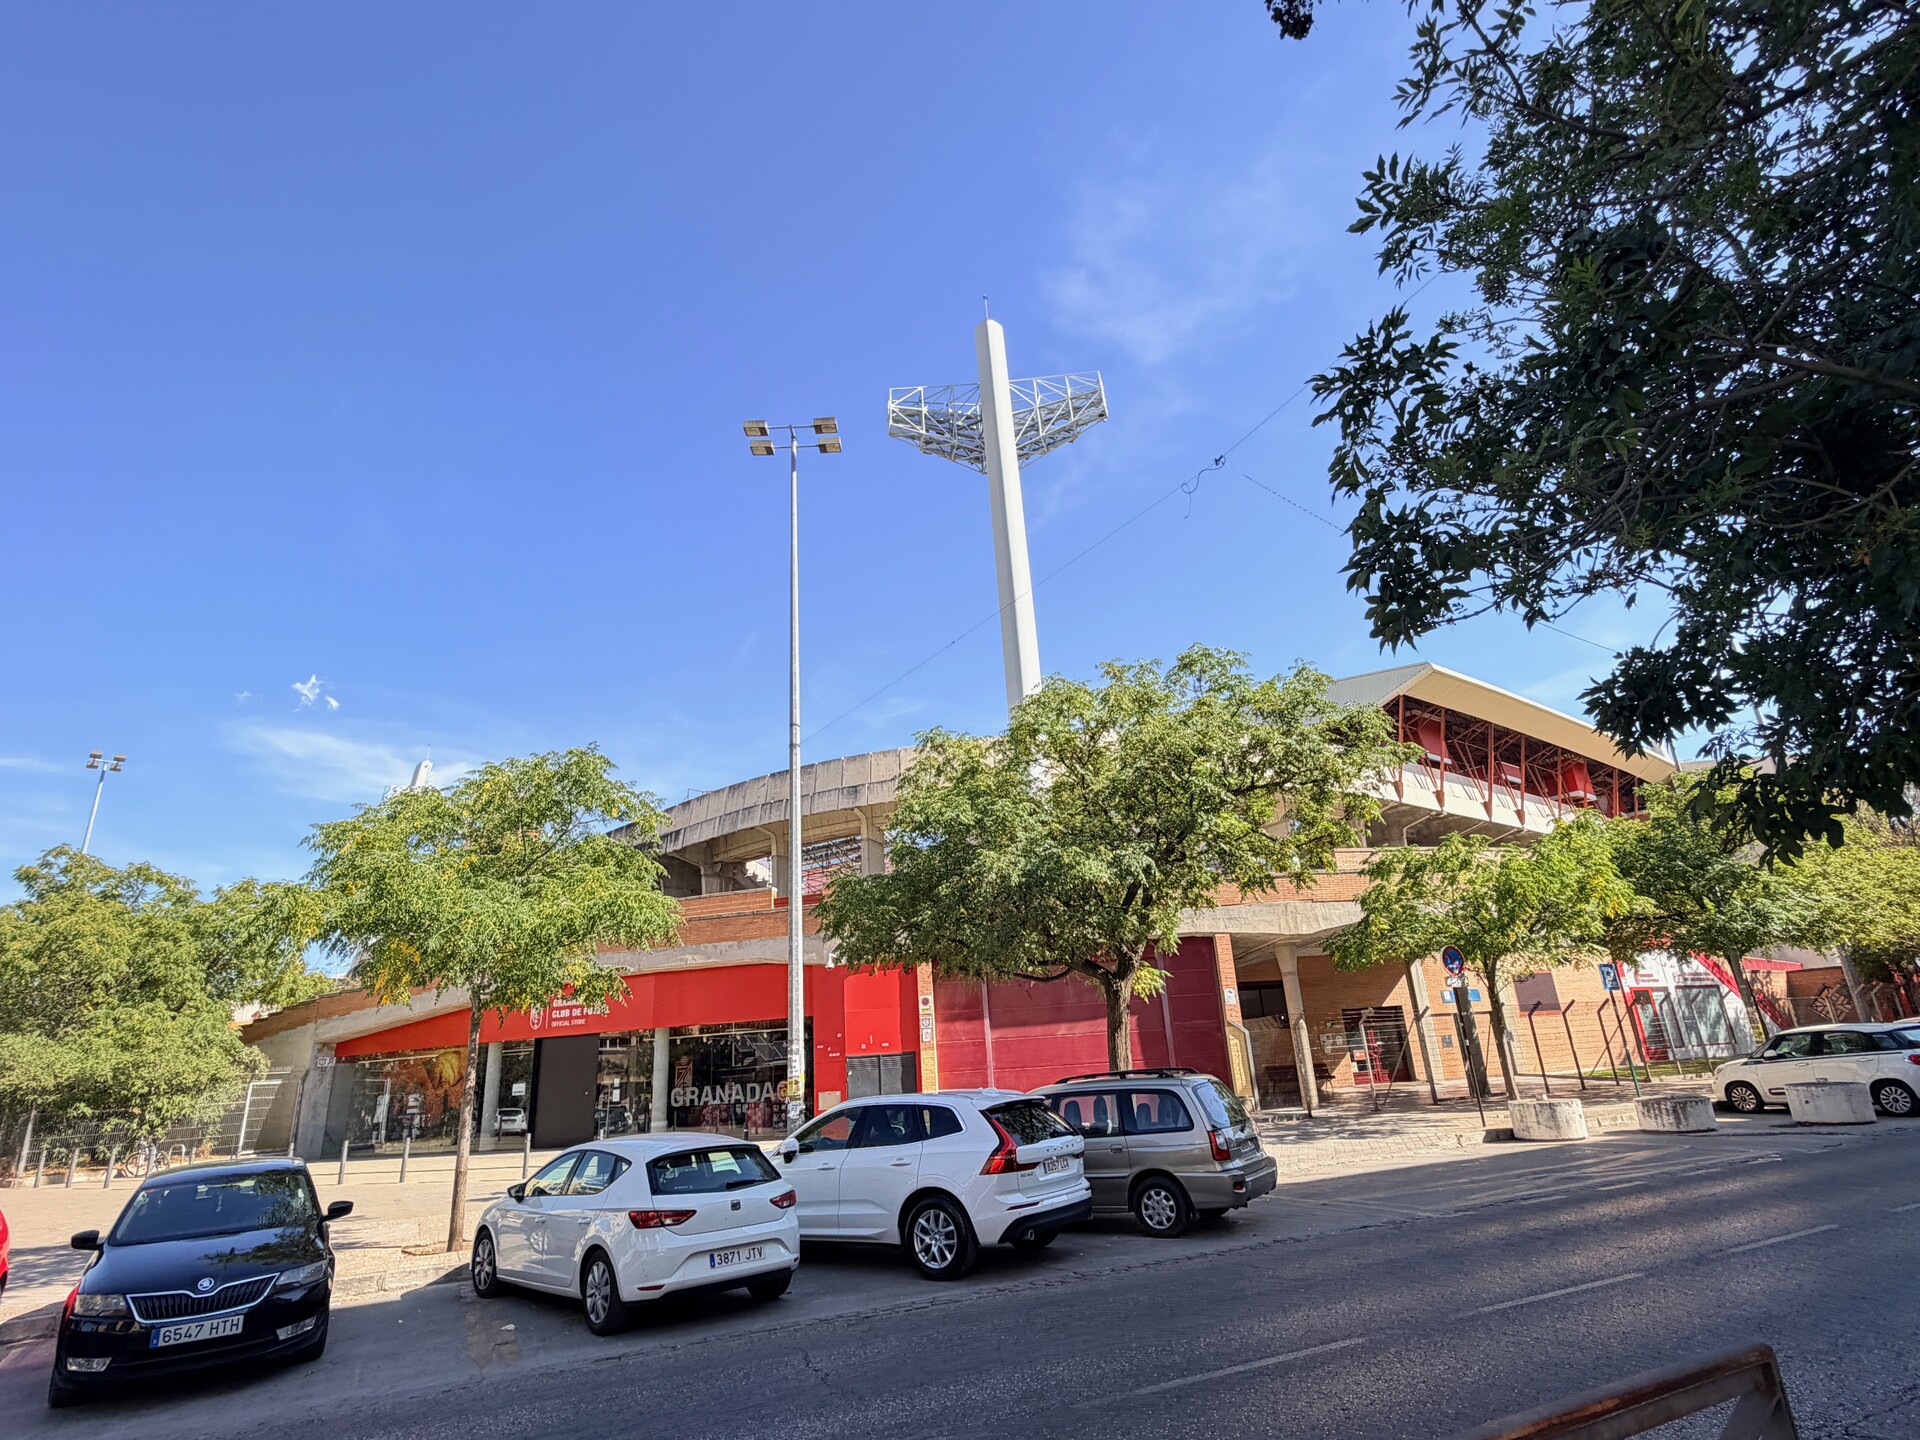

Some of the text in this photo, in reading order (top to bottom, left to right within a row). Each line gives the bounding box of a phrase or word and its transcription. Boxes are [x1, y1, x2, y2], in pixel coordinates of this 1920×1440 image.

[551, 1009, 570, 1019] CLUB
[571, 1008, 582, 1017] DE
[571, 1018, 586, 1026] STORE
[716, 1246, 763, 1266] 3871 JTV
[162, 1317, 240, 1344] 6547 HTH
